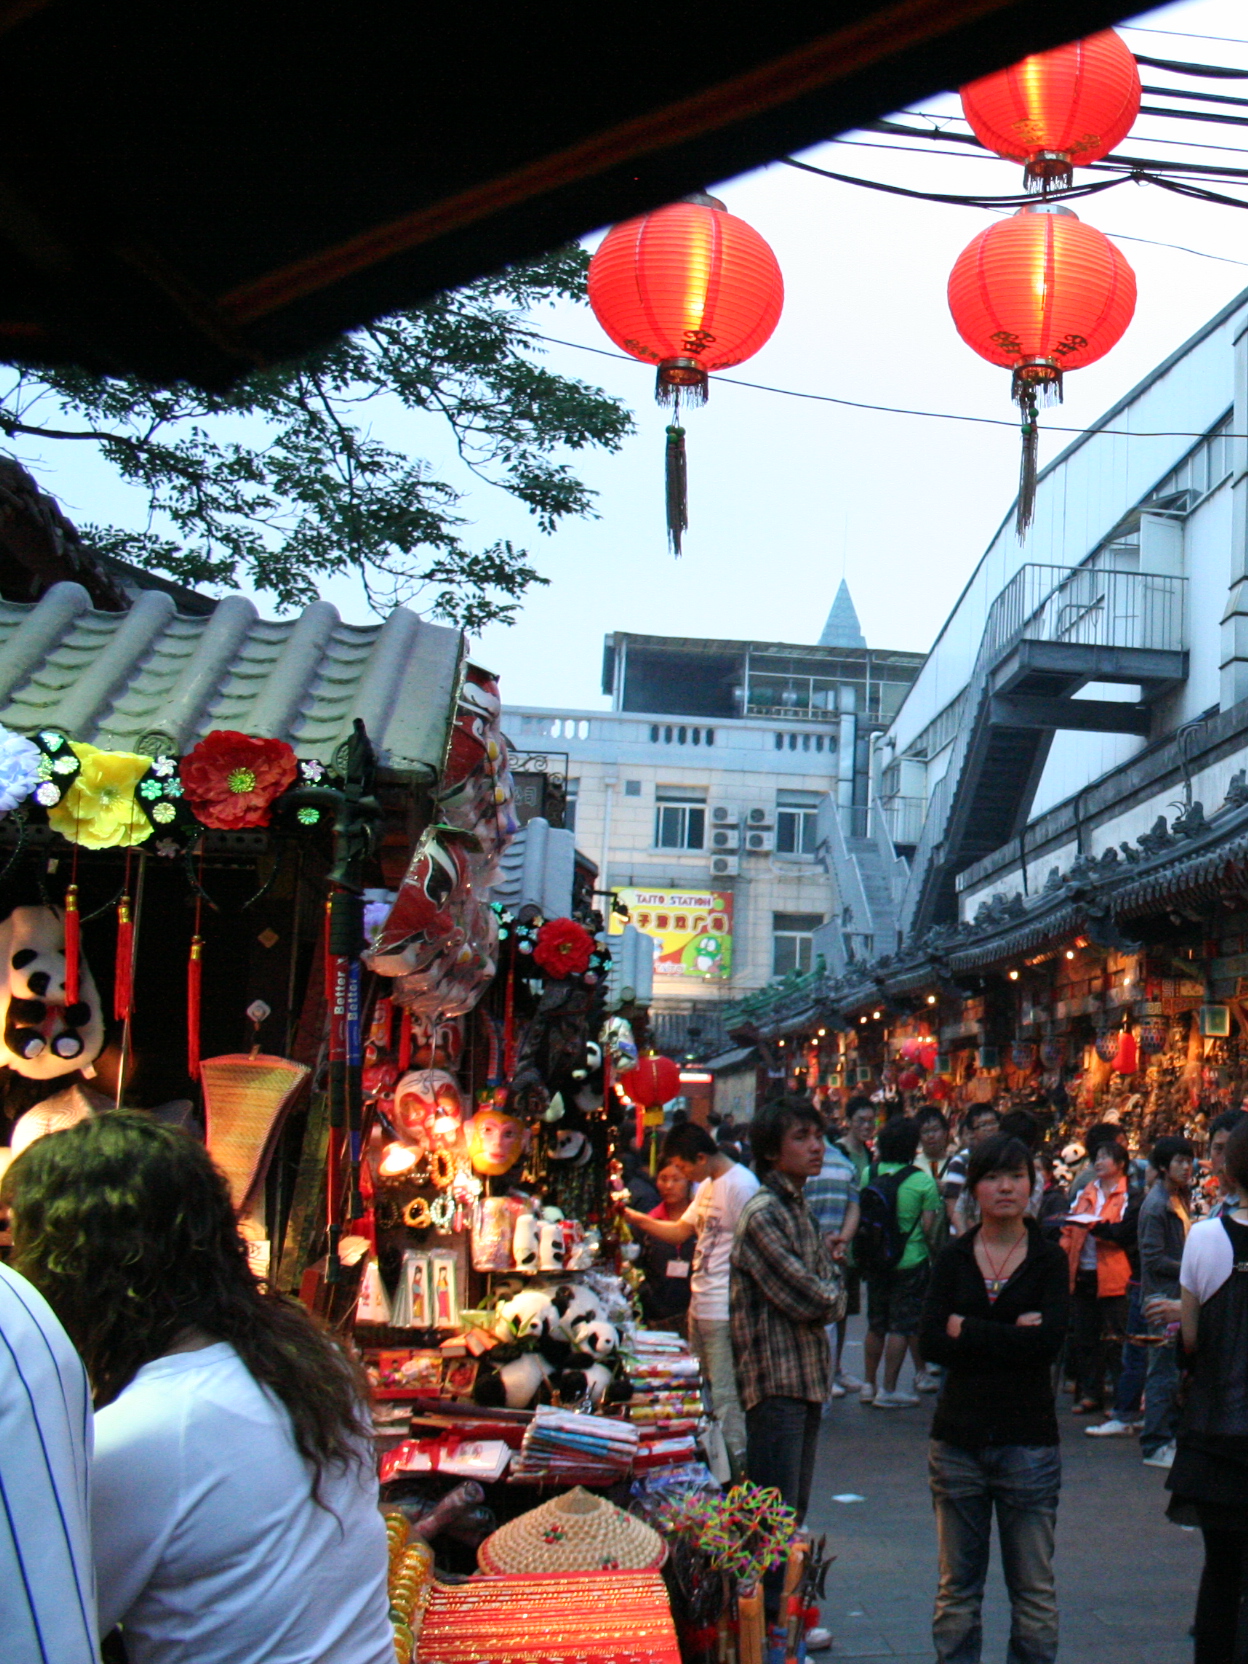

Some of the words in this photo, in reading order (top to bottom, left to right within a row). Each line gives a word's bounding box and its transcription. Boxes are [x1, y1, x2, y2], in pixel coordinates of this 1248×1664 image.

[637, 894, 665, 904] TAITO
[670, 895, 711, 906] STATION
[334, 971, 345, 1014] Better
[347, 979, 358, 1020] Better
